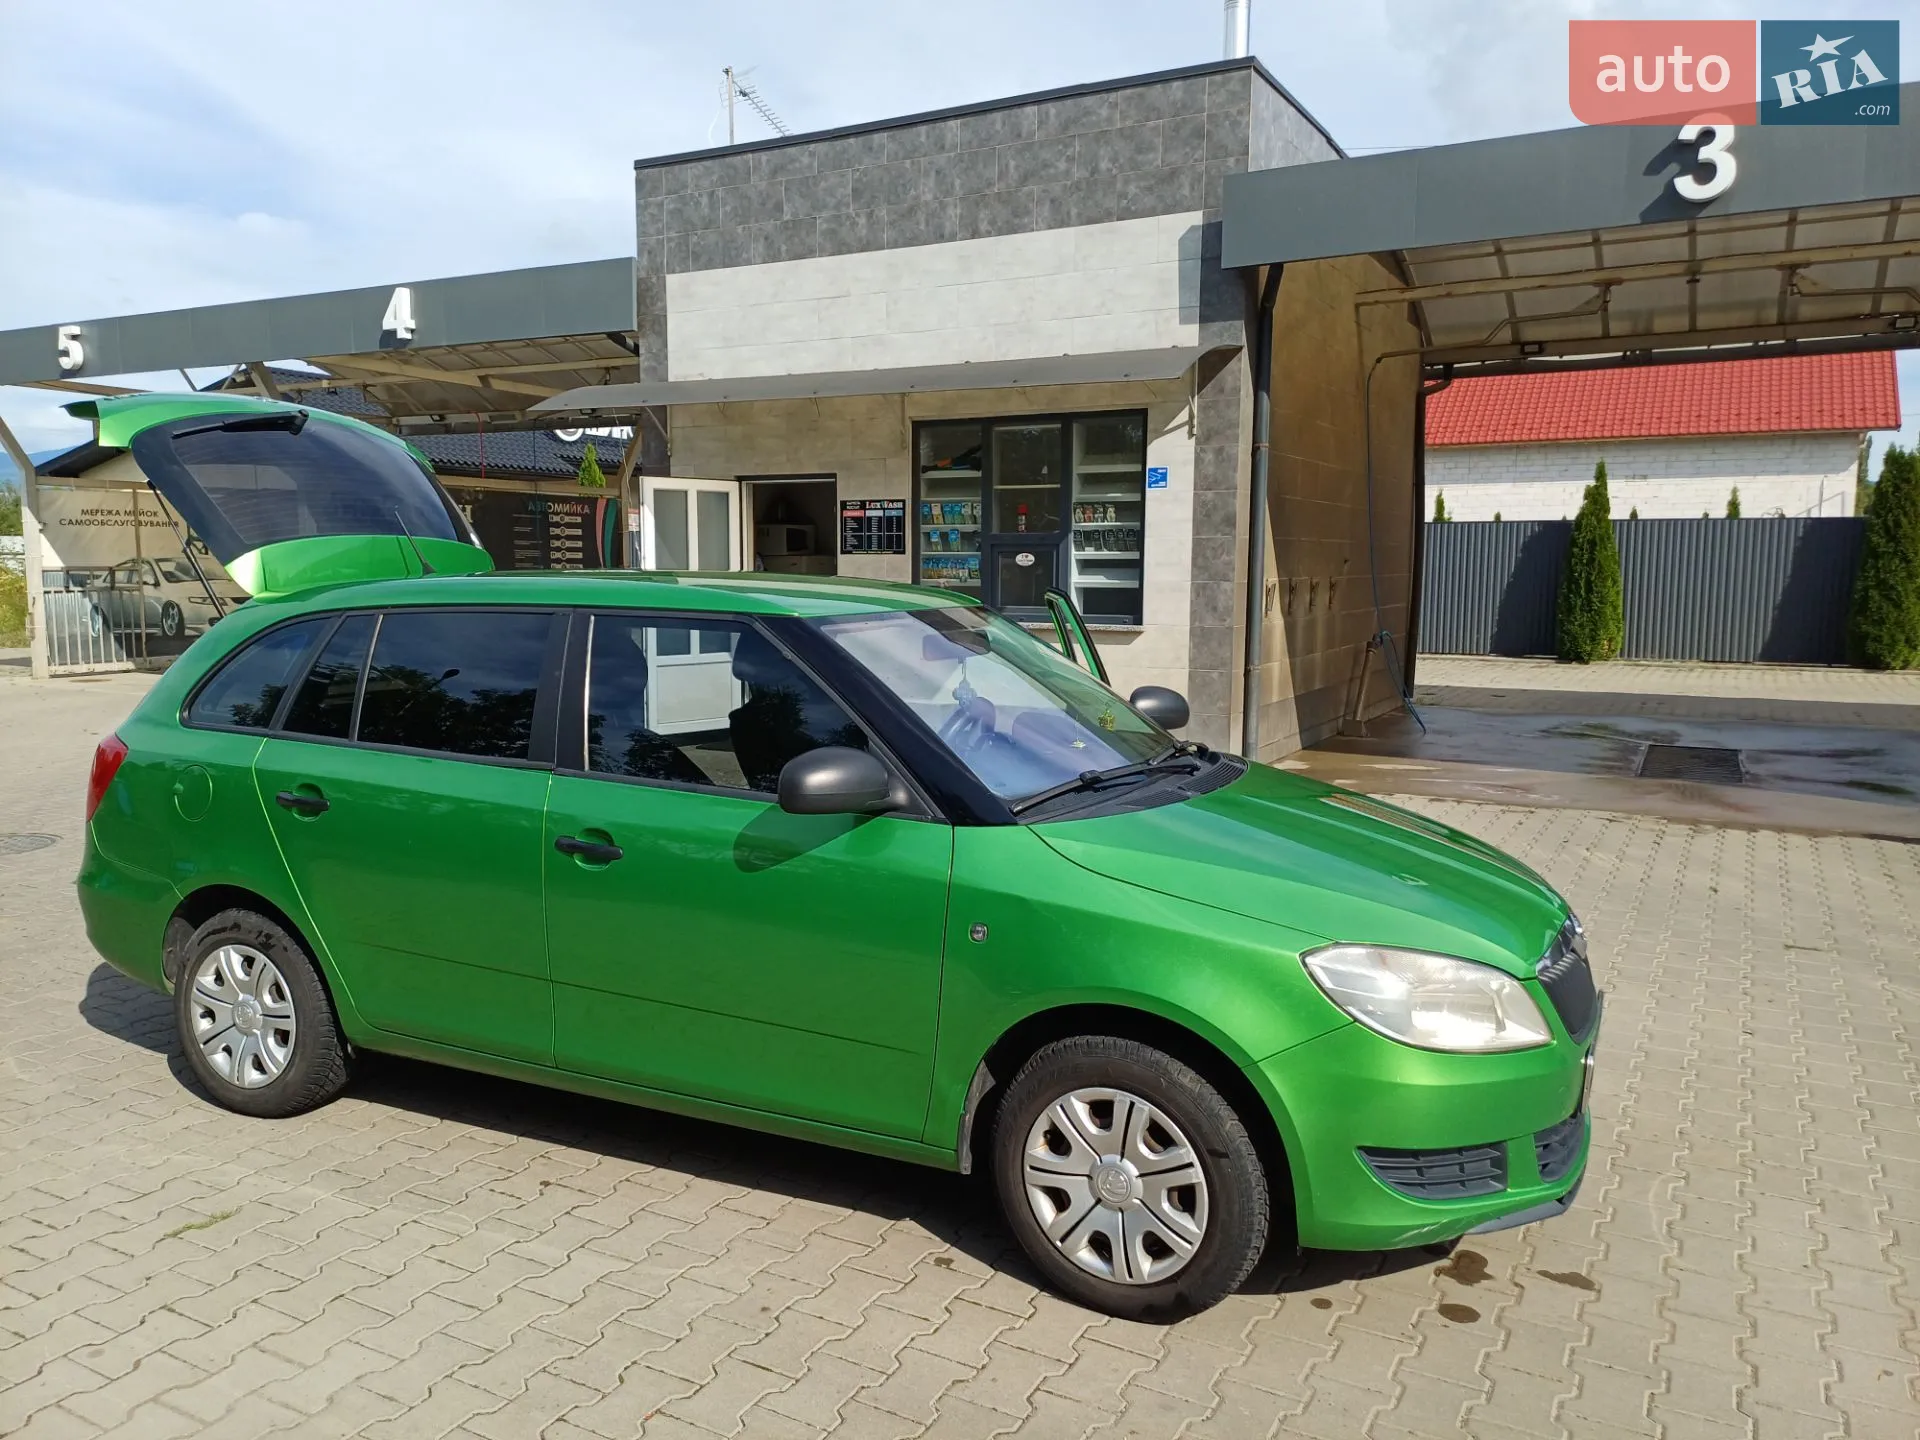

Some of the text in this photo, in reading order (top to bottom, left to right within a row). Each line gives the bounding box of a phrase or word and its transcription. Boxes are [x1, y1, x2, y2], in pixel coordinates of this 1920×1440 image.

[1673, 113, 1737, 204] 3
[382, 286, 416, 340] 4
[58, 325, 84, 370] 5
[80, 508, 121, 517] МЕРЕЖА
[527, 501, 591, 514] АВТОМИЙКА
